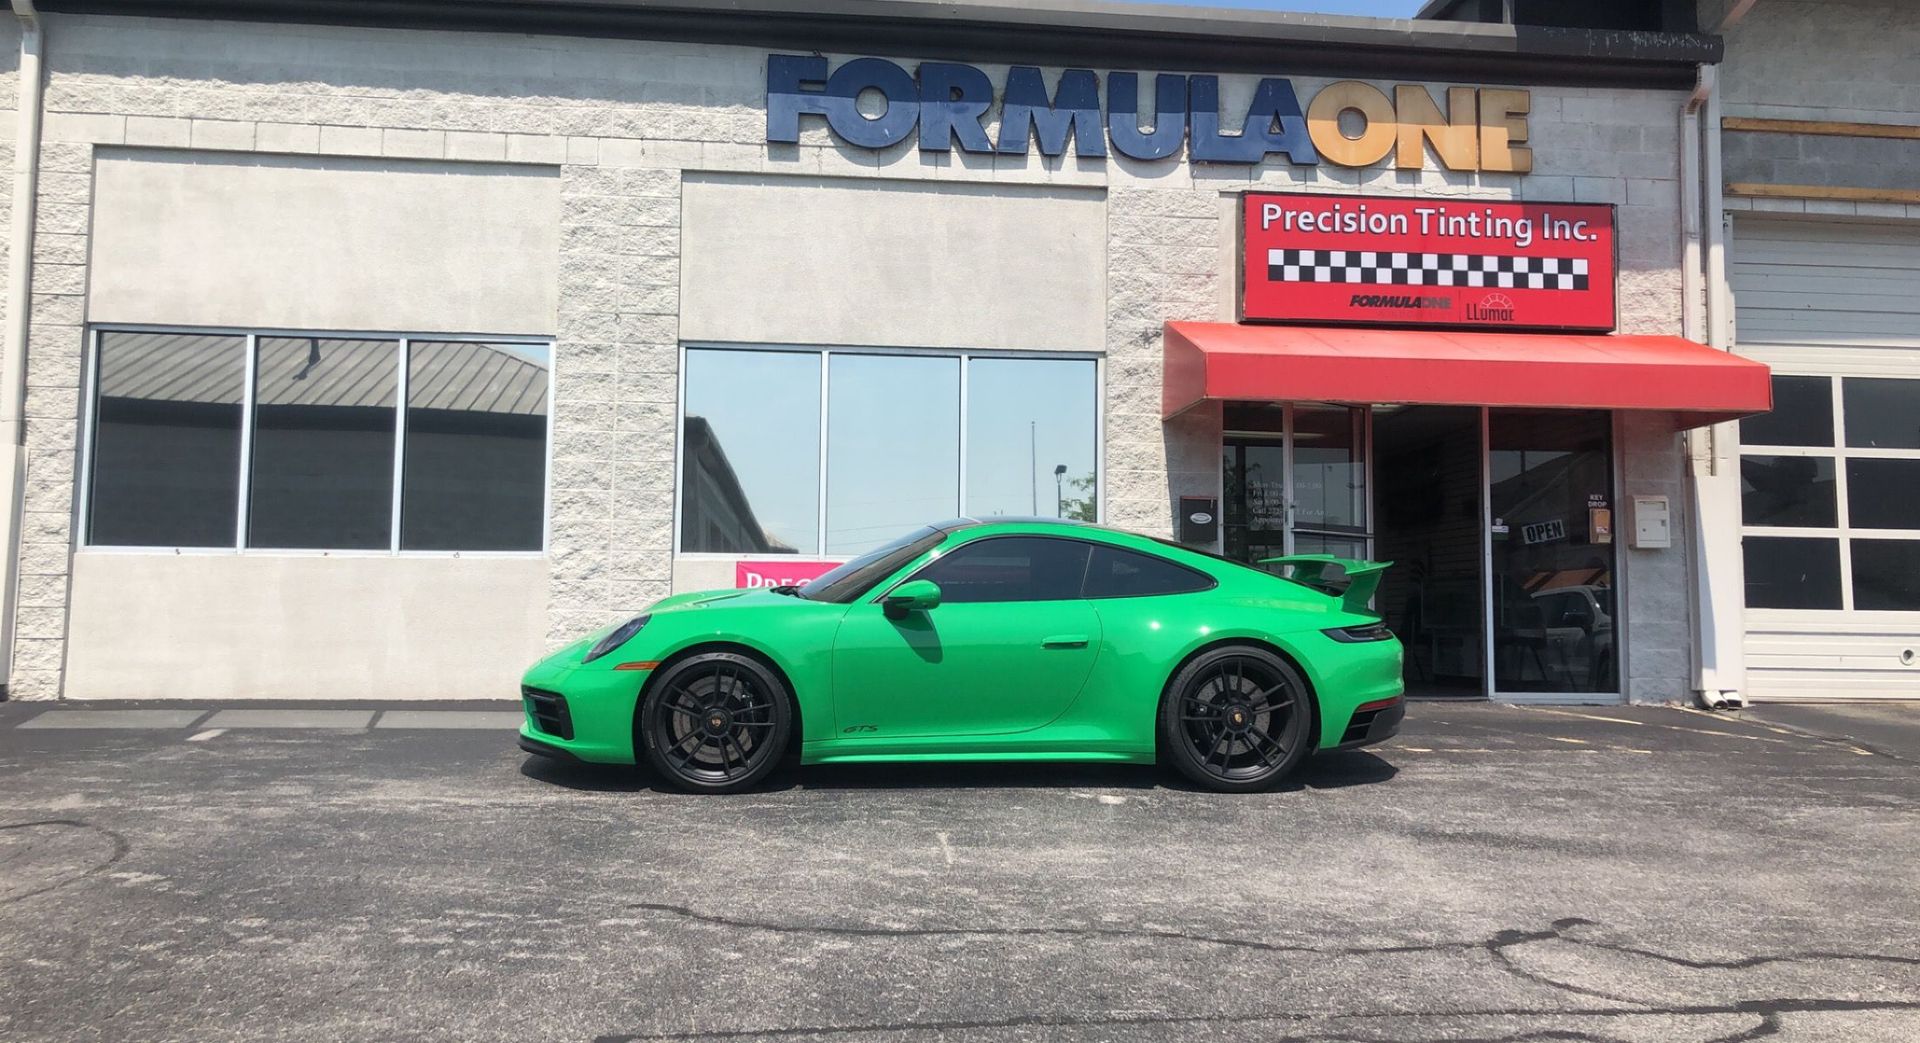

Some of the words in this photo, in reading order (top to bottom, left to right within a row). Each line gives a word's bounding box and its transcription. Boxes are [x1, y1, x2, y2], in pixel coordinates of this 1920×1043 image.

[1261, 203, 1409, 235] Precision
[1415, 207, 1533, 247] Tinting
[1542, 212, 1598, 242] Inc.
[1527, 520, 1562, 542] OPEN
[842, 724, 878, 734] GTS
